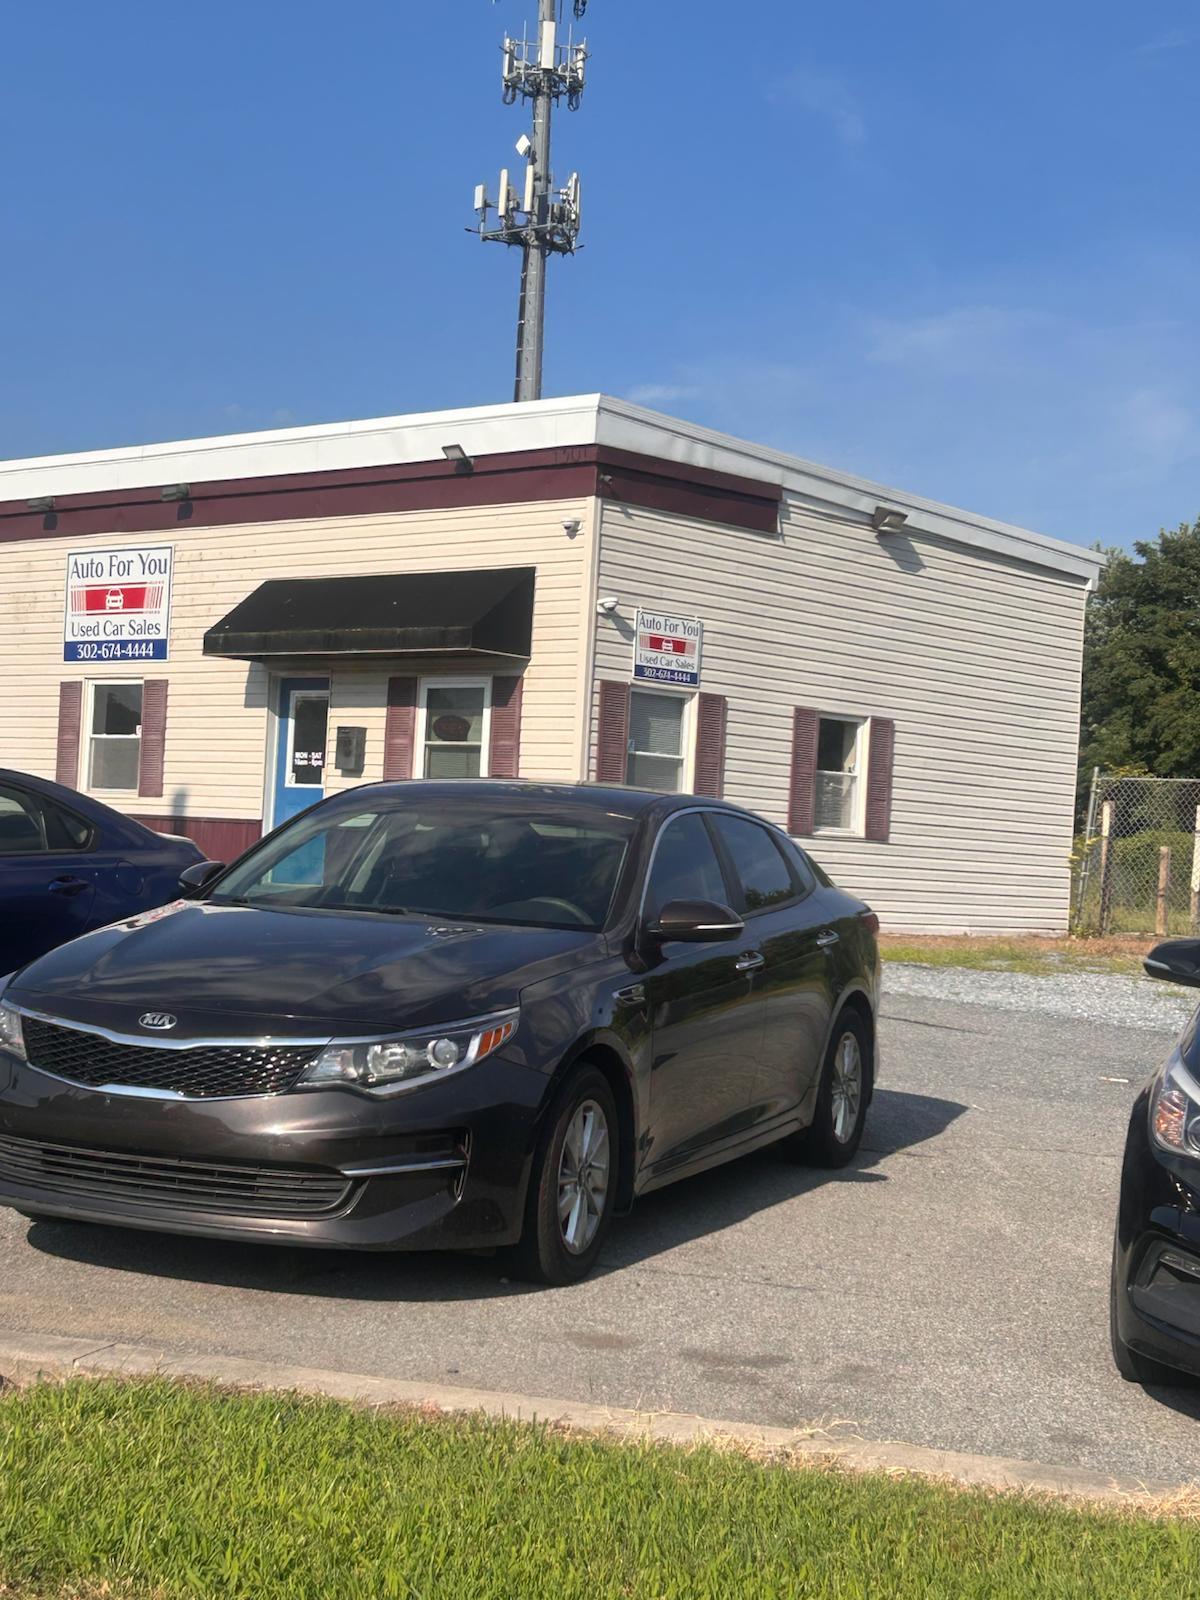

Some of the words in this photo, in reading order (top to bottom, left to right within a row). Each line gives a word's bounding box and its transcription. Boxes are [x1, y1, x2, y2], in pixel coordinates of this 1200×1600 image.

[70, 558, 104, 579] Auto
[109, 555, 134, 577] For
[138, 553, 168, 575] You
[71, 621, 100, 637] Used
[103, 620, 125, 636] Car
[128, 619, 161, 636] Sales
[640, 615, 661, 631] Auto
[664, 618, 680, 633] For
[682, 622, 699, 637] You
[77, 642, 154, 659] 302-674-4444
[640, 653, 658, 665] Used
[660, 656, 674, 667] Car
[675, 658, 695, 670] Sales
[294, 751, 309, 759] MON
[311, 751, 323, 759] SAT
[143, 1014, 170, 1025] KIA
